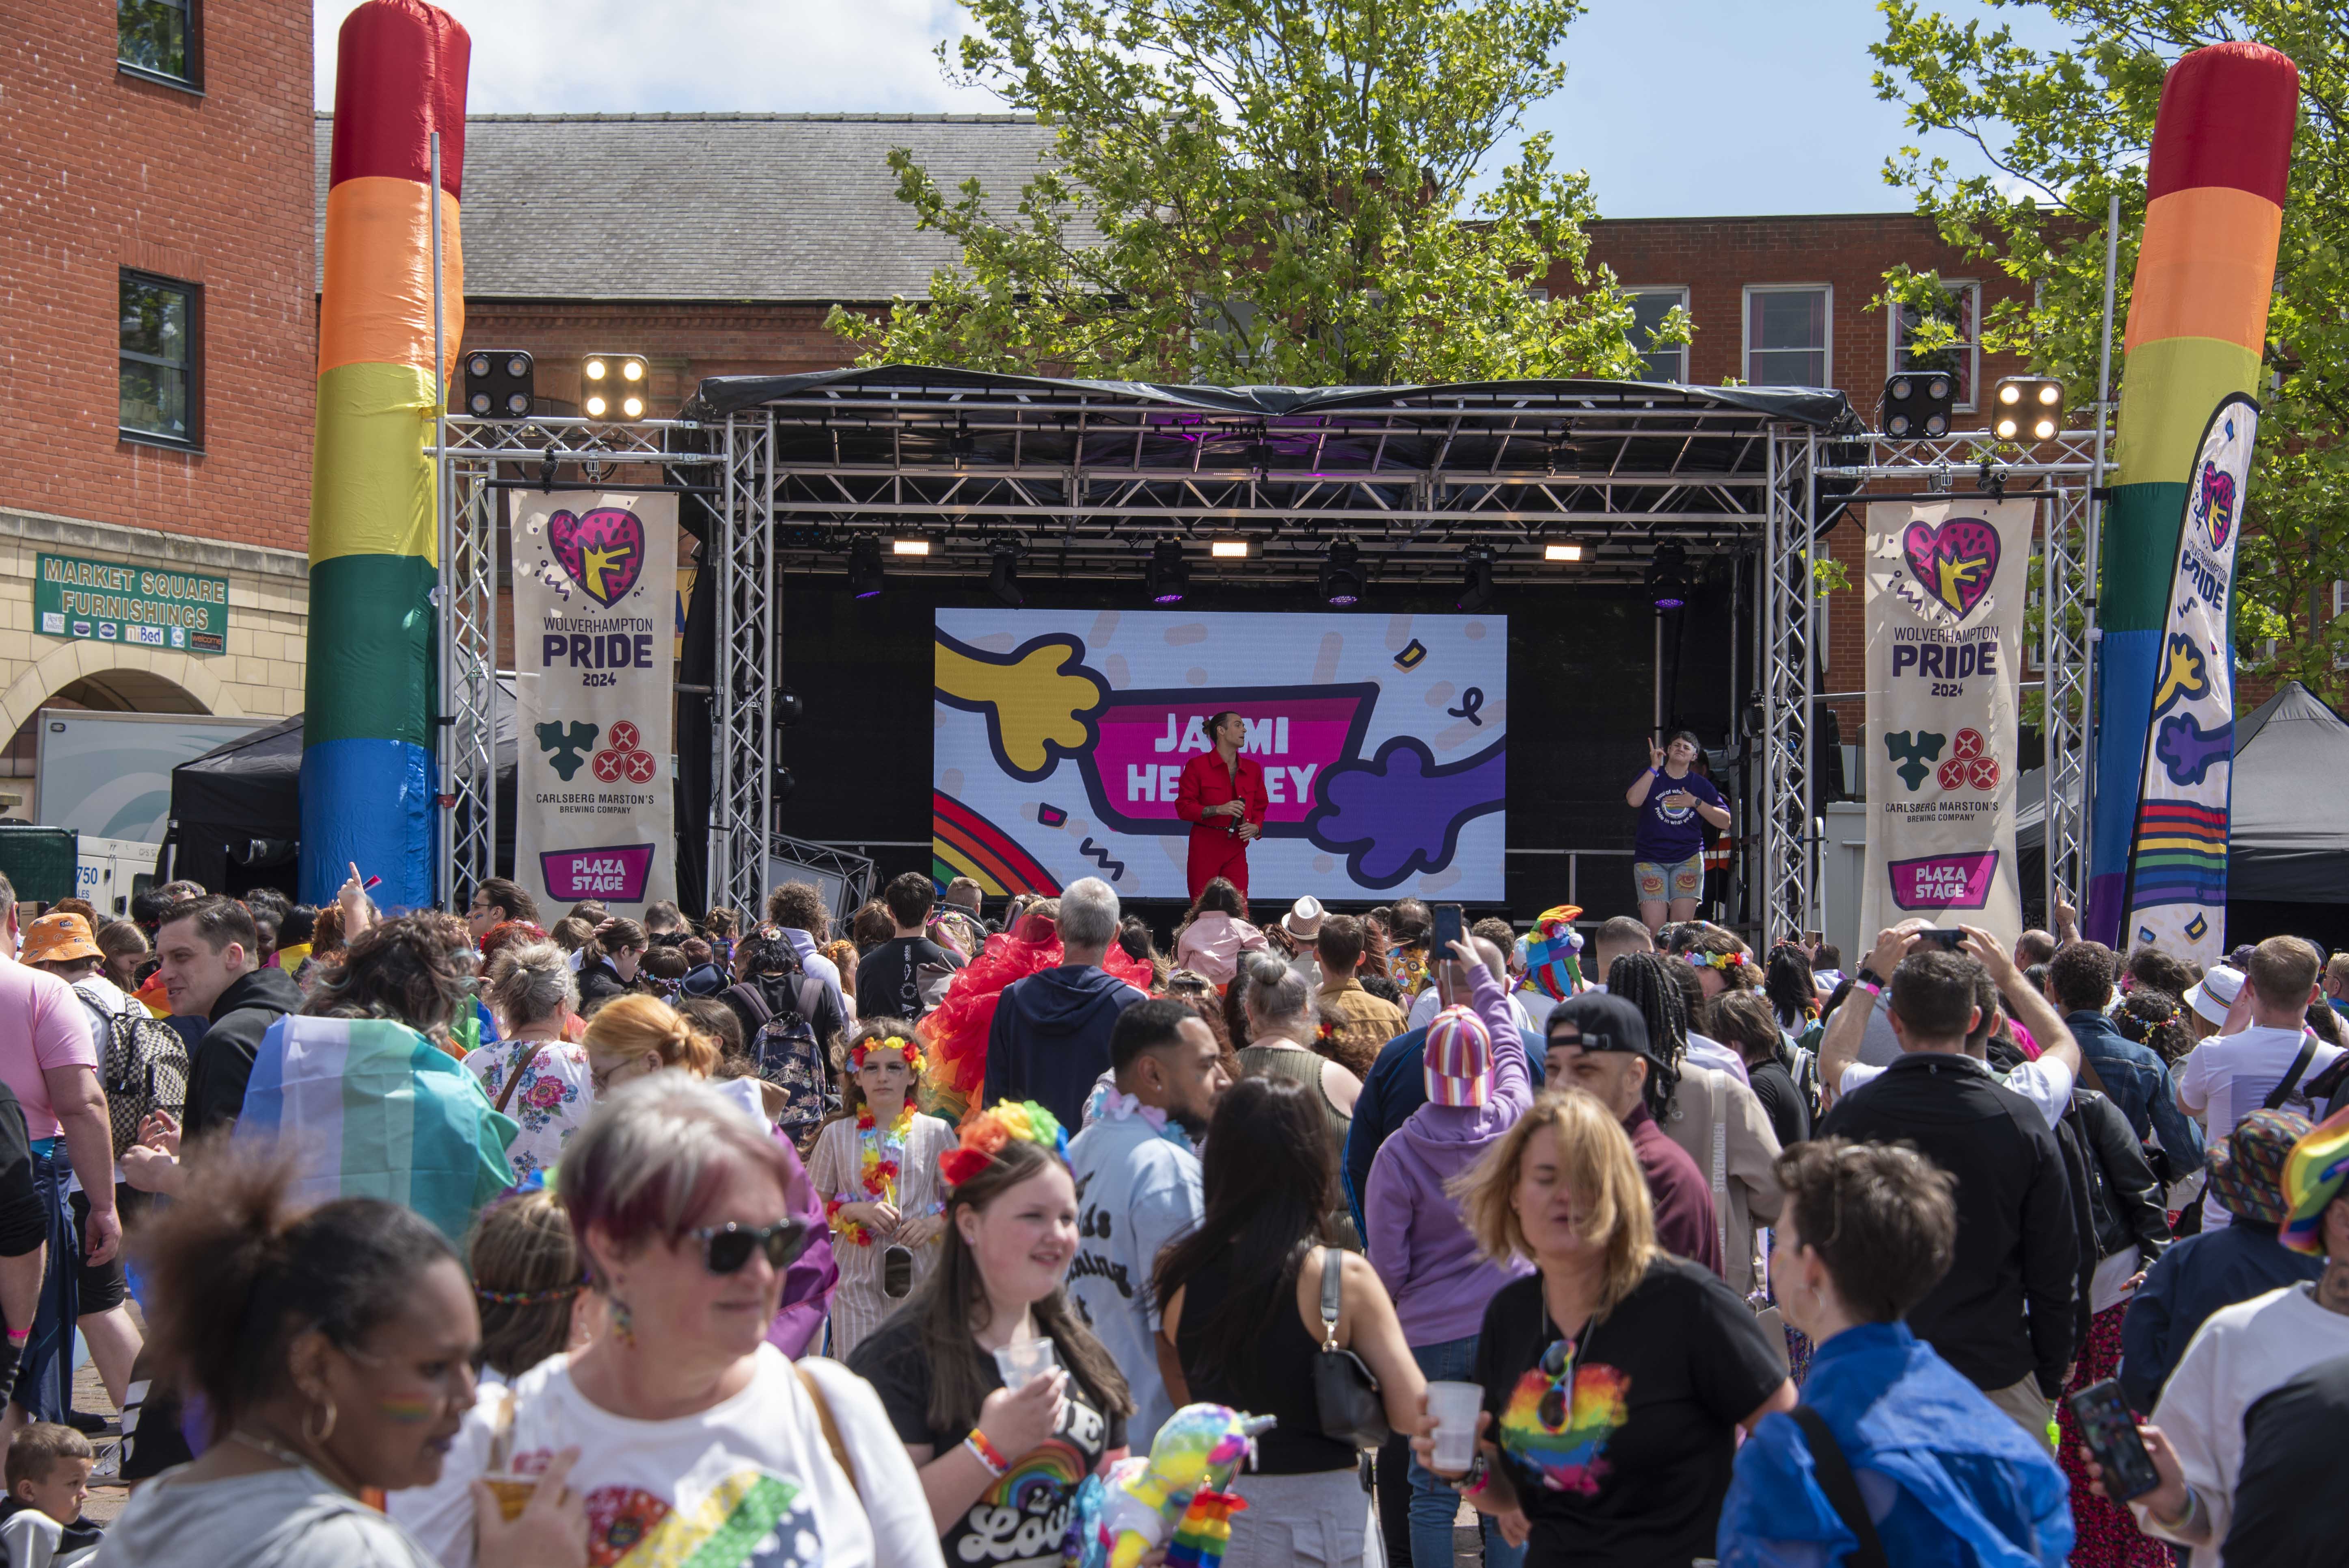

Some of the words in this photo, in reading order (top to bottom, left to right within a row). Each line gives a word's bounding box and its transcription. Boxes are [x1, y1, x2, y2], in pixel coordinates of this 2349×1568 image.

[44, 558, 134, 591] MARKET
[141, 572, 225, 604] SQUARE
[62, 590, 208, 630] FURNISHINGS
[544, 617, 652, 633] WOLVERHAMPTON
[192, 635, 222, 645] welcome
[1894, 626, 1999, 643] WOLVERHAMPTON
[543, 633, 653, 669] PRIDE
[1892, 642, 1997, 679] PRIDE
[583, 672, 617, 687] 2024
[1931, 682, 1963, 697] 2024
[1155, 713, 1289, 755] JAMI
[1127, 764, 1317, 803] HEEY
[536, 794, 595, 803] CARLSBERG
[599, 795, 654, 804] MARSTON'S
[1655, 790, 1666, 801] Proud
[560, 806, 595, 814] BREWING
[597, 806, 631, 814] COMPANY
[1655, 807, 1665, 820] Pride
[1885, 802, 1936, 813] CARLSBERG
[1939, 801, 1998, 812] MARSTON'S
[1907, 814, 1936, 823] BREWING
[572, 857, 626, 876] PLAZA
[1916, 865, 1967, 883] PLAZA
[77, 866, 97, 884] 750
[572, 876, 624, 892] STAGE
[1915, 883, 1965, 900] STAGE
